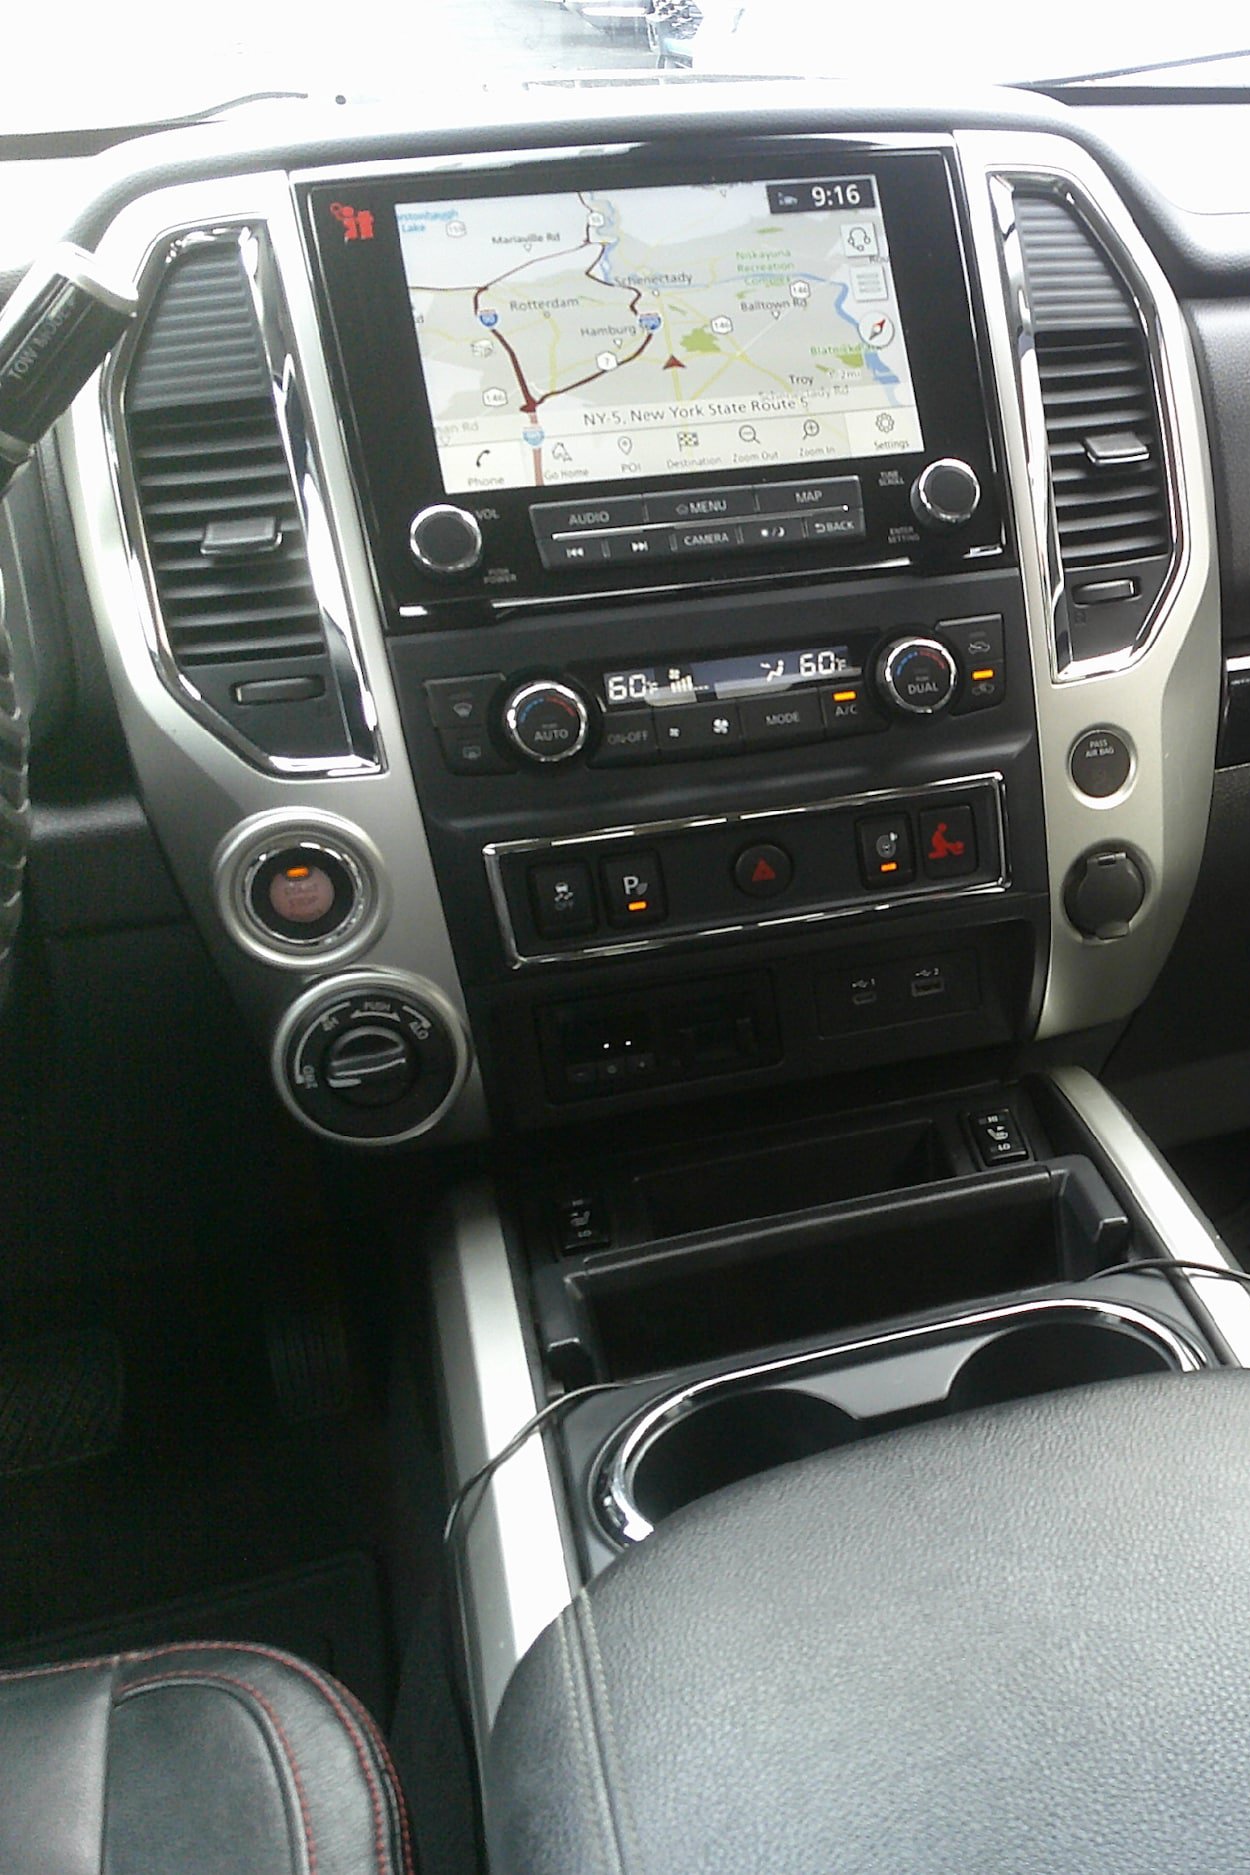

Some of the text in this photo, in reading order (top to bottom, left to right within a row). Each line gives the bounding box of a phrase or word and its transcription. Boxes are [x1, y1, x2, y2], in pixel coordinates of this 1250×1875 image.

[811, 183, 860, 207] 9:16
[547, 232, 561, 242] Rd
[510, 298, 580, 312] Rotterdam
[740, 300, 790, 312] Balltown
[581, 325, 637, 340] Hamburg
[8, 340, 39, 380] TOW
[788, 374, 814, 387] Troy
[631, 409, 665, 421] New
[668, 403, 704, 419] York
[709, 402, 747, 415] State
[751, 398, 796, 412] Route
[873, 438, 911, 455] Settings
[467, 475, 505, 488] Phone
[795, 489, 824, 503] MAP
[475, 508, 501, 520] VOL
[689, 499, 728, 515] MENU
[568, 510, 610, 526] AUDIO
[826, 520, 855, 534] BACK
[683, 530, 729, 546] CAMERA
[907, 681, 940, 696] DUAL
[765, 711, 801, 726] MODE
[835, 704, 859, 718] A/C
[533, 728, 569, 743] AUTO
[623, 875, 641, 895] P
[997, 1142, 1012, 1152] LO
